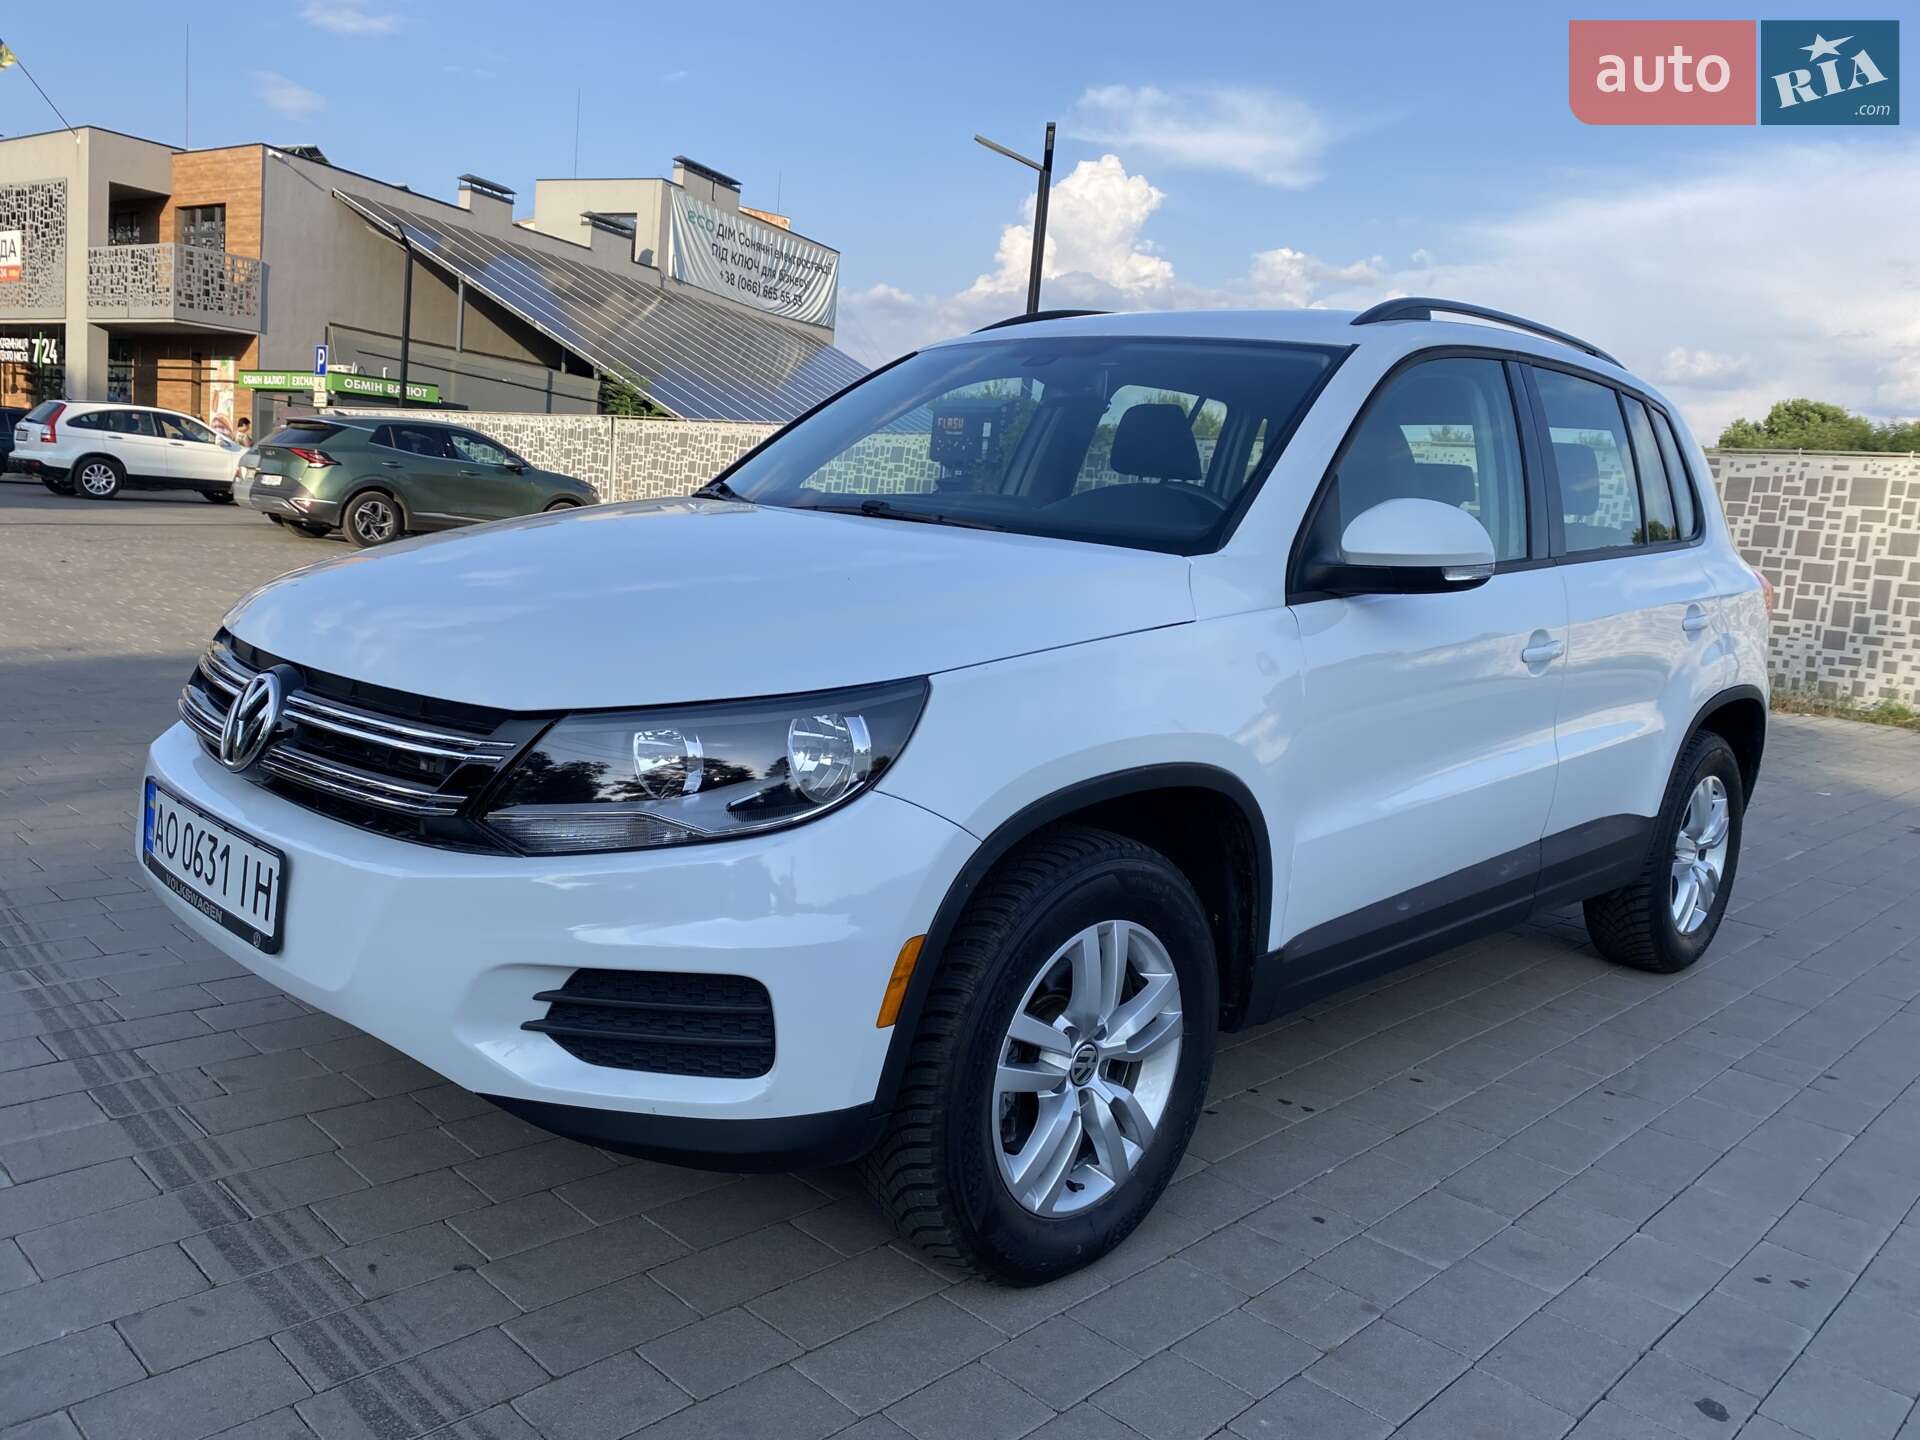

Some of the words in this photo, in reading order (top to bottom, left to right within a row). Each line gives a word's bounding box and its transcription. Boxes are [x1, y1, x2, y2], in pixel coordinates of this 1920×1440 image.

[716, 223, 735, 242] ДІМ
[738, 232, 773, 256] Сонячні
[711, 243, 728, 265] ПІД
[731, 250, 760, 273] КЛЮЧ
[760, 266, 777, 280] для
[317, 348, 325, 372] P
[344, 378, 382, 393] ОБМІН
[155, 803, 178, 859] AO
[182, 822, 230, 896] 0631
[240, 854, 273, 921] IH
[165, 873, 223, 924] VOLKSWAGEN
